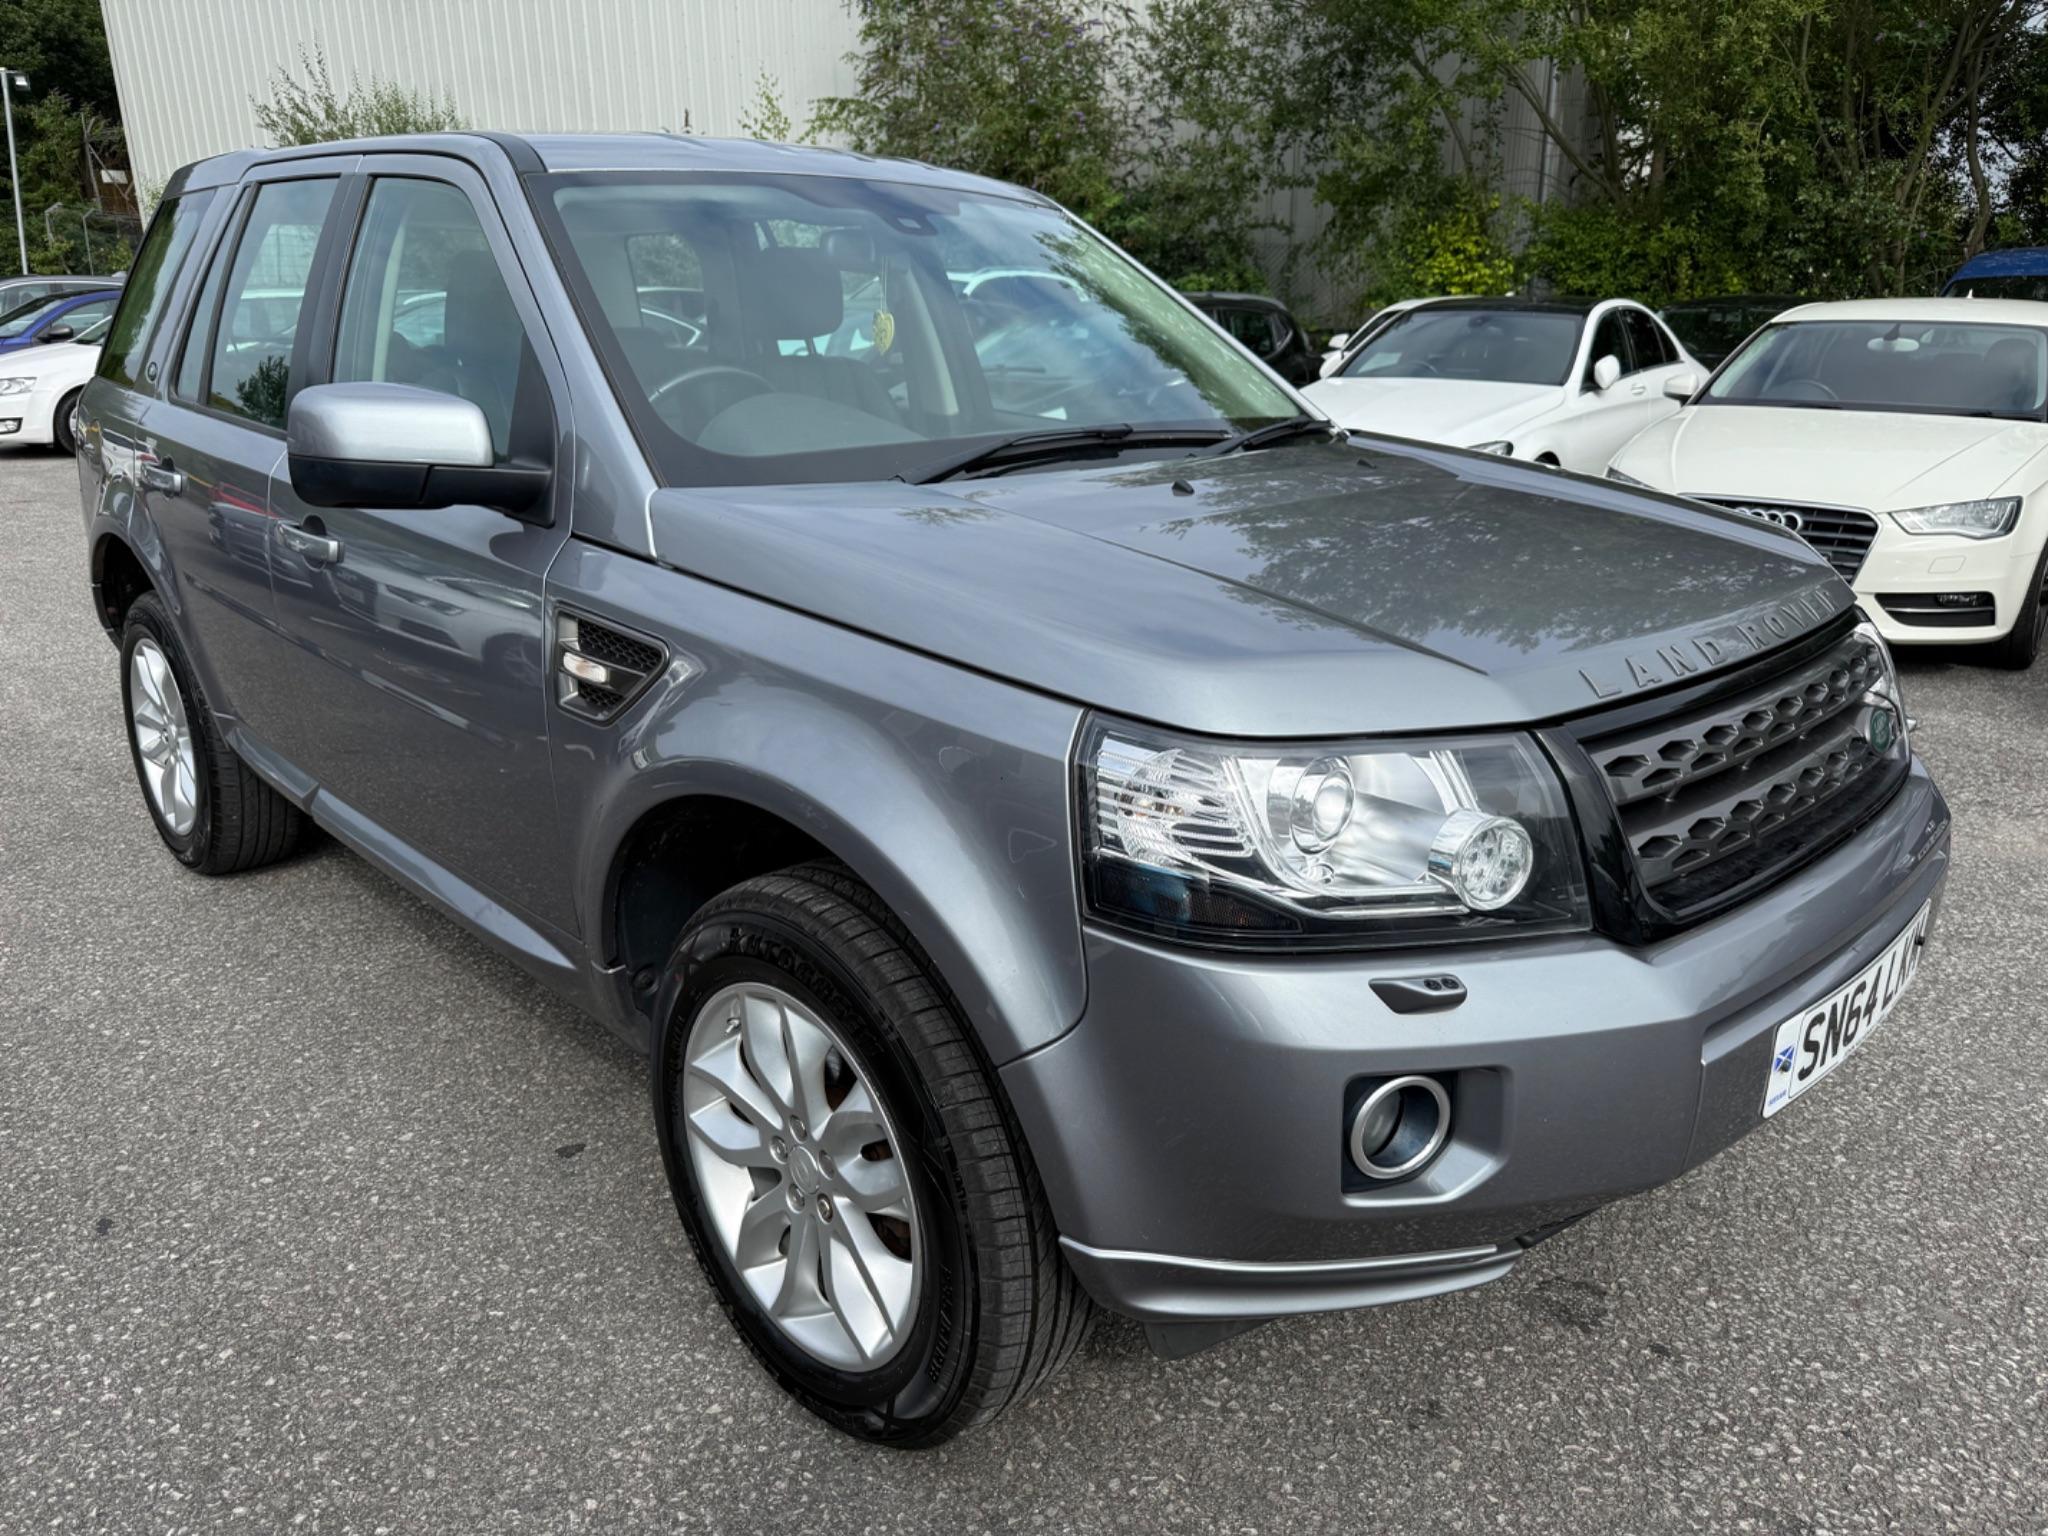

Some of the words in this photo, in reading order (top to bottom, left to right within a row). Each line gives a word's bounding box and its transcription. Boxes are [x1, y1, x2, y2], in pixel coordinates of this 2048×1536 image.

[1579, 637, 1727, 698] LAND
[1736, 588, 1839, 648] ROVER
[1798, 965, 1882, 1081] SN64
